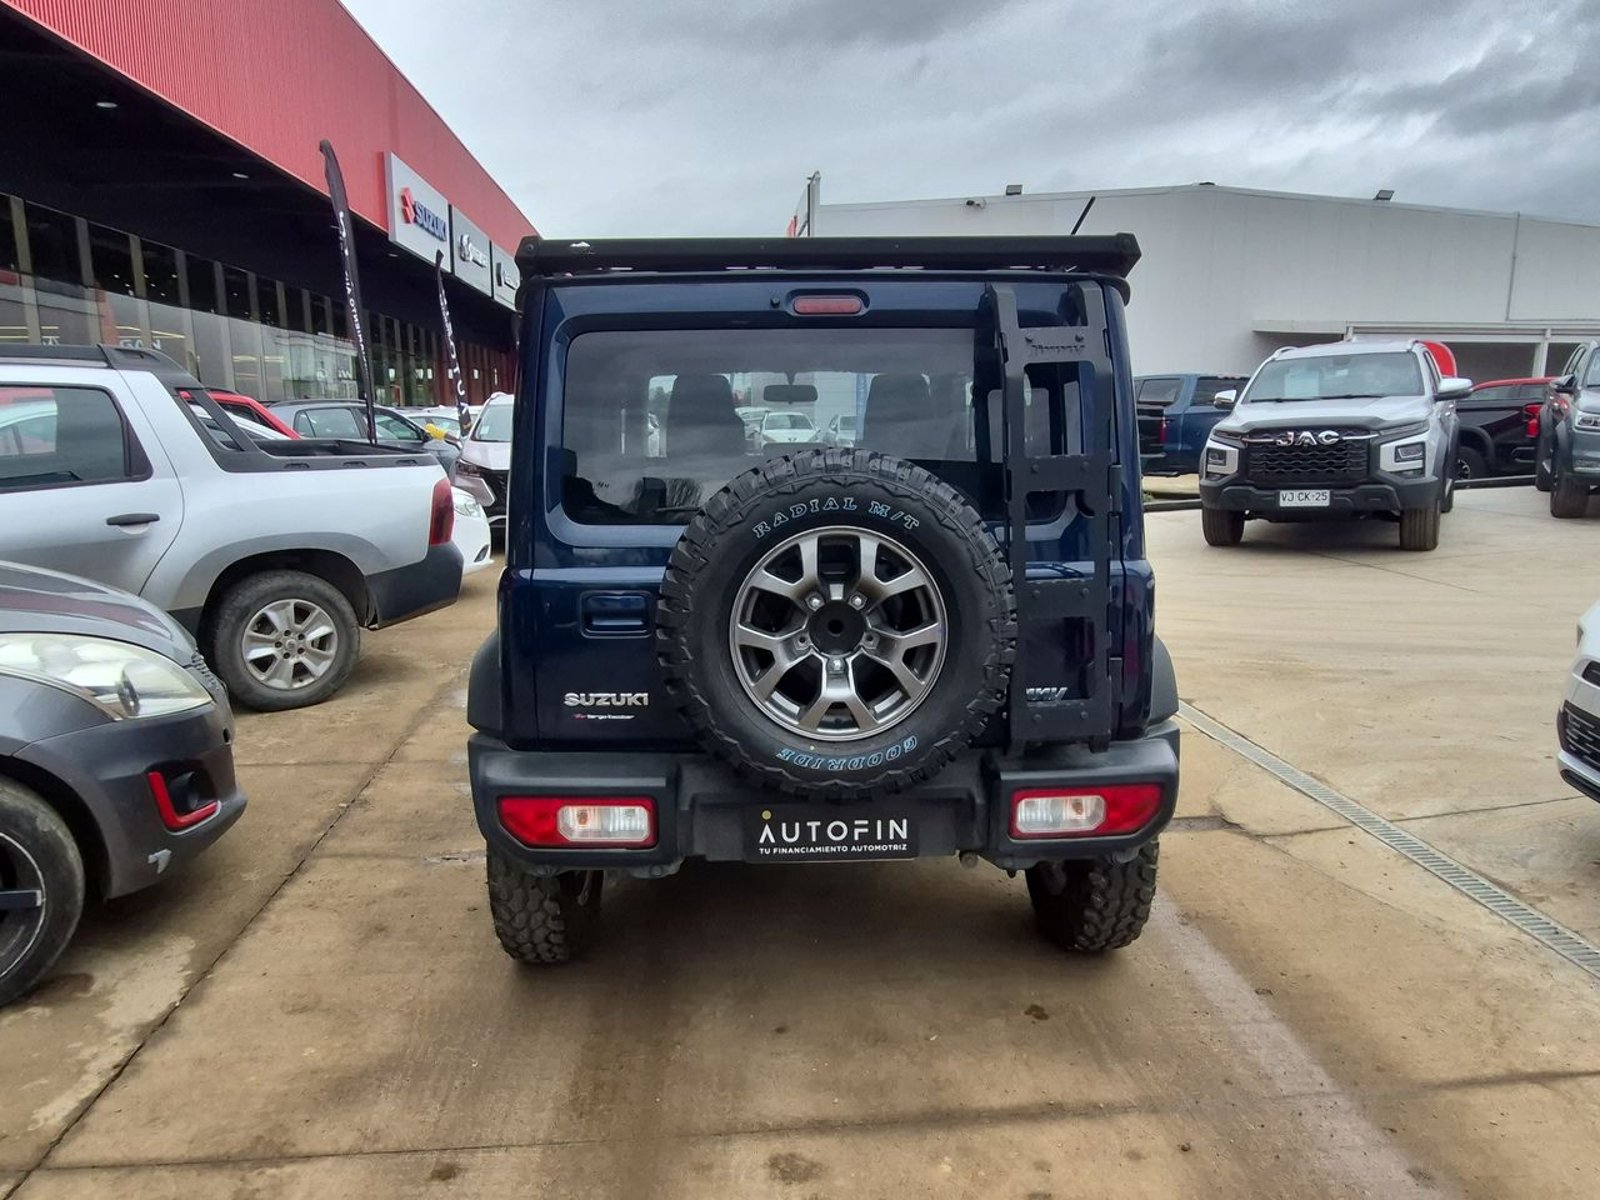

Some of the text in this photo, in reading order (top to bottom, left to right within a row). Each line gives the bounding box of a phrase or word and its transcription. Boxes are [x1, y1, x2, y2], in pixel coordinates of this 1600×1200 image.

[1276, 430, 1340, 447] JAC
[1281, 492, 1295, 501] VJ
[752, 497, 920, 538] RADIAL M/T
[563, 692, 649, 707] SUZUKI
[776, 735, 918, 771] GOODRIDE
[759, 818, 908, 844] AUTOFIN
[773, 845, 849, 855] FINANCIAMIENTO
[850, 843, 908, 853] AUTOMOTRIZ
